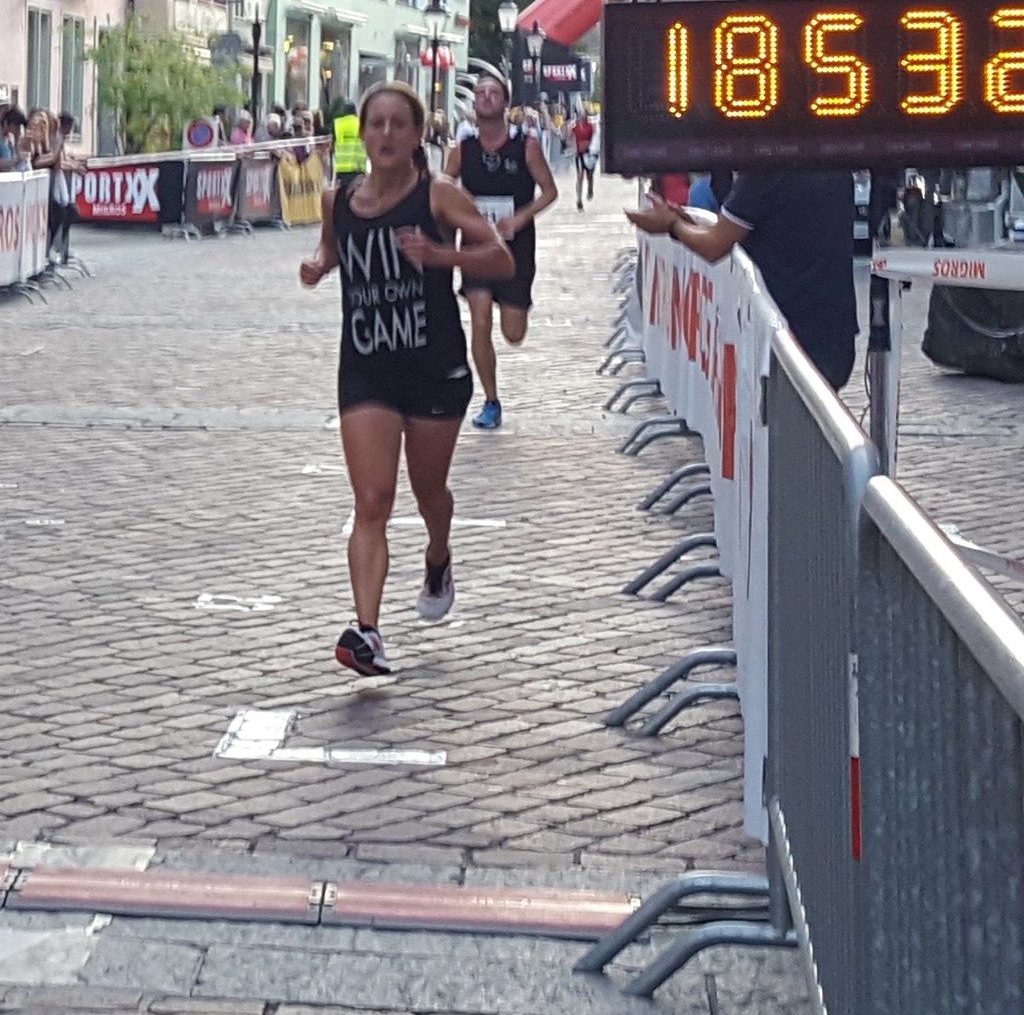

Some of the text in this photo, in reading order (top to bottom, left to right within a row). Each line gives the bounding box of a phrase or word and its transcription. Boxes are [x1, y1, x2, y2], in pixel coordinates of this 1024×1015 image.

[70, 167, 161, 215] PORTXX
[932, 257, 986, 279] MIGROS
[348, 282, 381, 307] OUR
[350, 300, 427, 356] GAME
